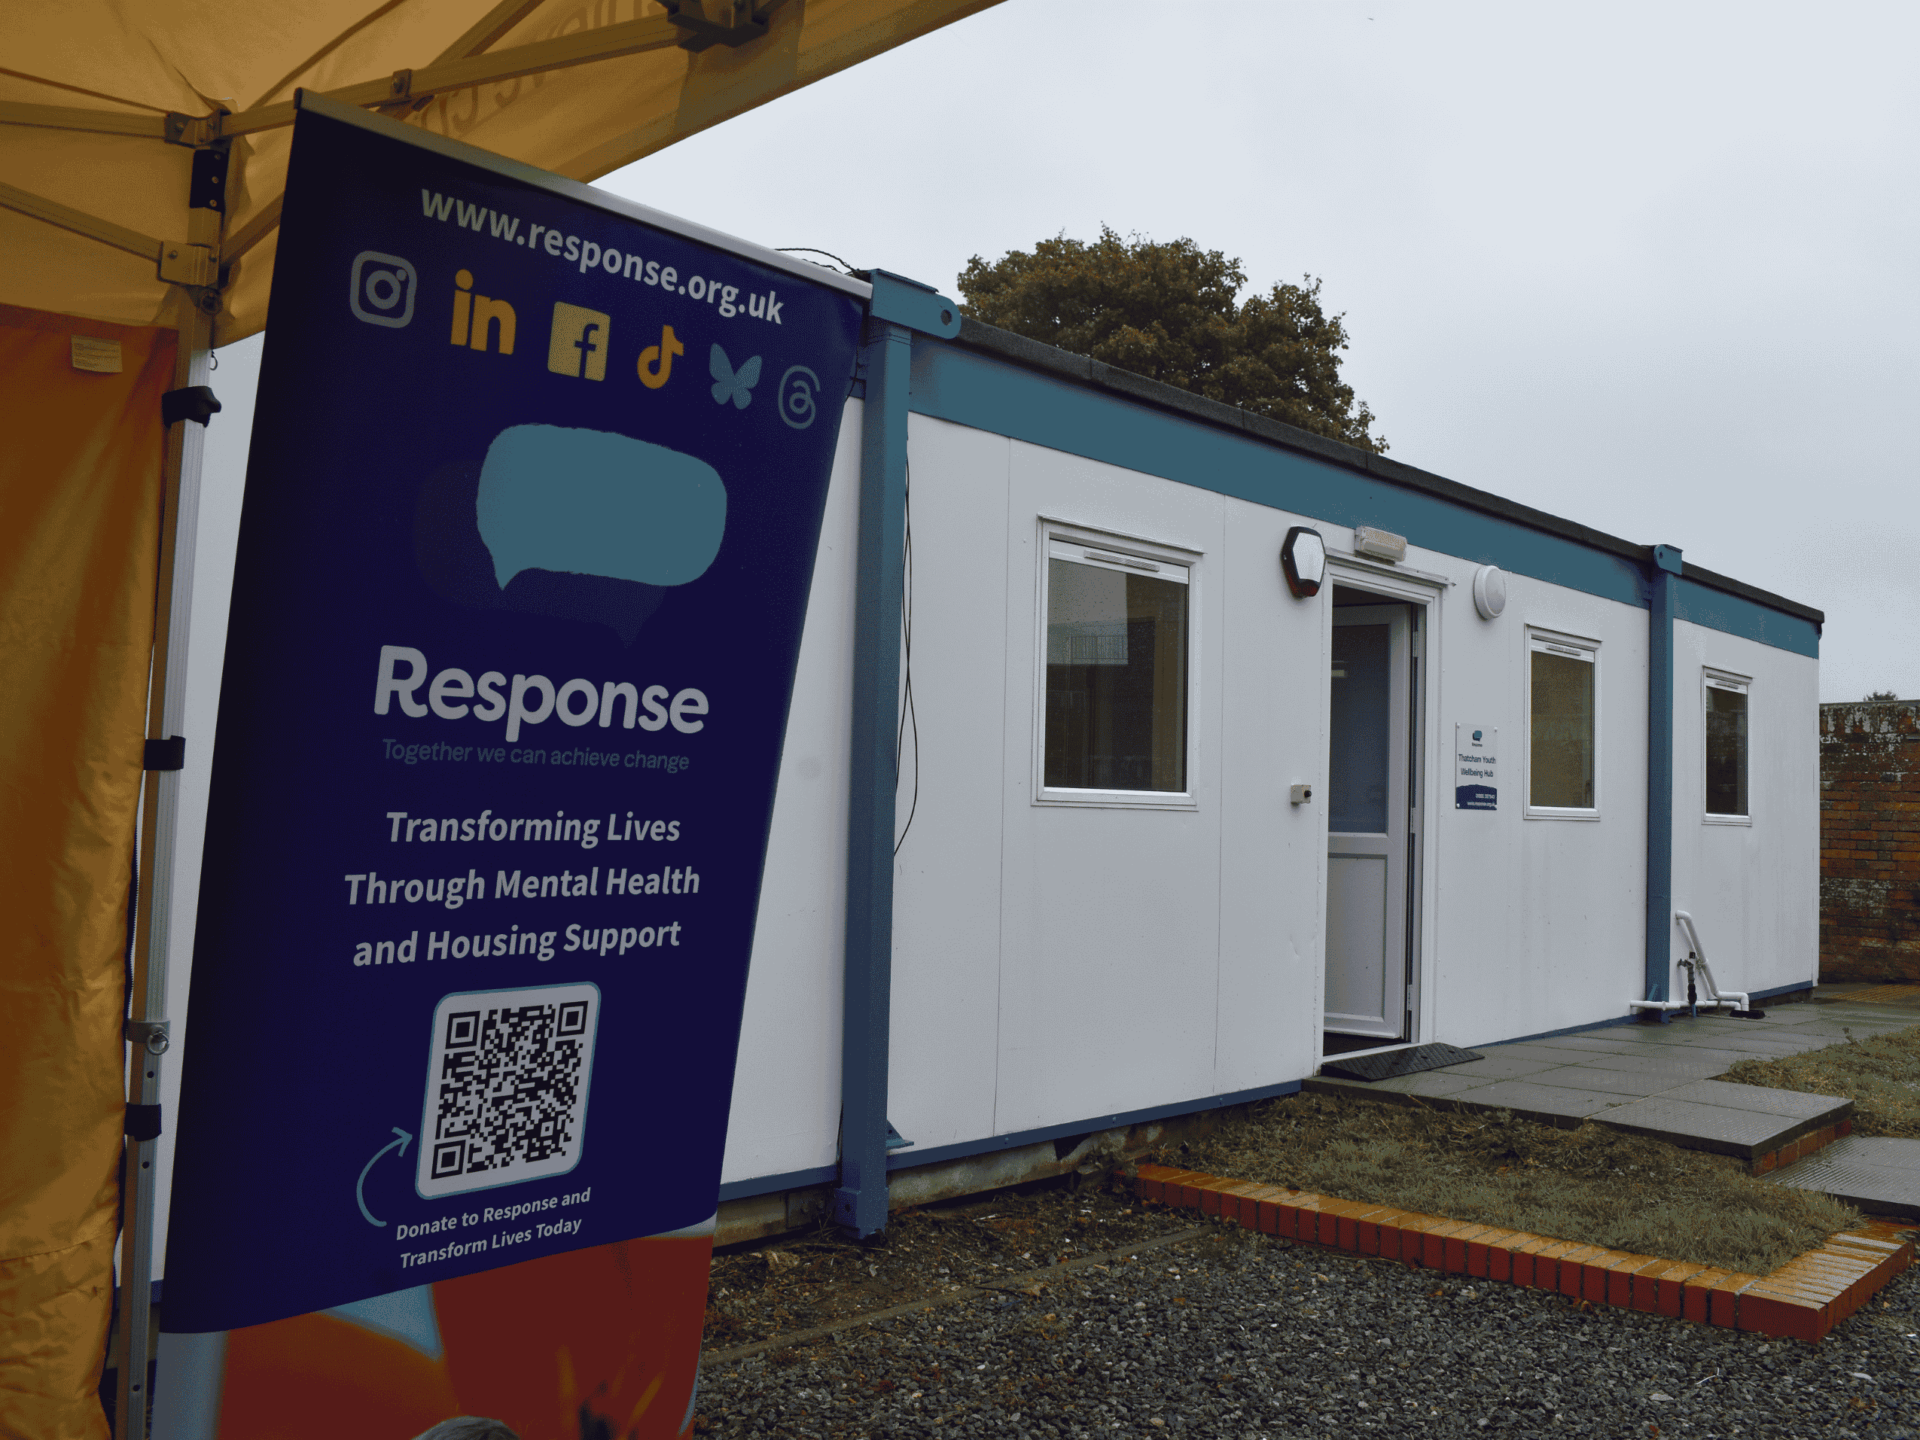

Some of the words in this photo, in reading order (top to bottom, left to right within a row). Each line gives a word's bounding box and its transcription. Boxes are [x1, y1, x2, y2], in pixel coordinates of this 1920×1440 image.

[421, 189, 784, 325] www.response.org.uk
[450, 268, 517, 355] in
[374, 645, 709, 742] Response
[382, 739, 473, 764] Together
[477, 746, 505, 762] we
[510, 747, 546, 764] can
[550, 747, 620, 767] achieve
[624, 750, 690, 774] change
[386, 810, 600, 849] Transforming
[607, 812, 680, 841] Lives
[345, 869, 485, 909] Through
[495, 867, 599, 899] Mental
[606, 866, 700, 896] Health
[353, 931, 418, 966] and
[427, 925, 556, 961] Housing
[563, 922, 681, 956] Support
[396, 1216, 457, 1240] Donate
[461, 1213, 479, 1226] to
[483, 1197, 558, 1222] Response
[561, 1187, 591, 1206] and
[400, 1239, 487, 1268] Transform
[491, 1229, 532, 1249] Lives
[536, 1219, 582, 1239] Today
